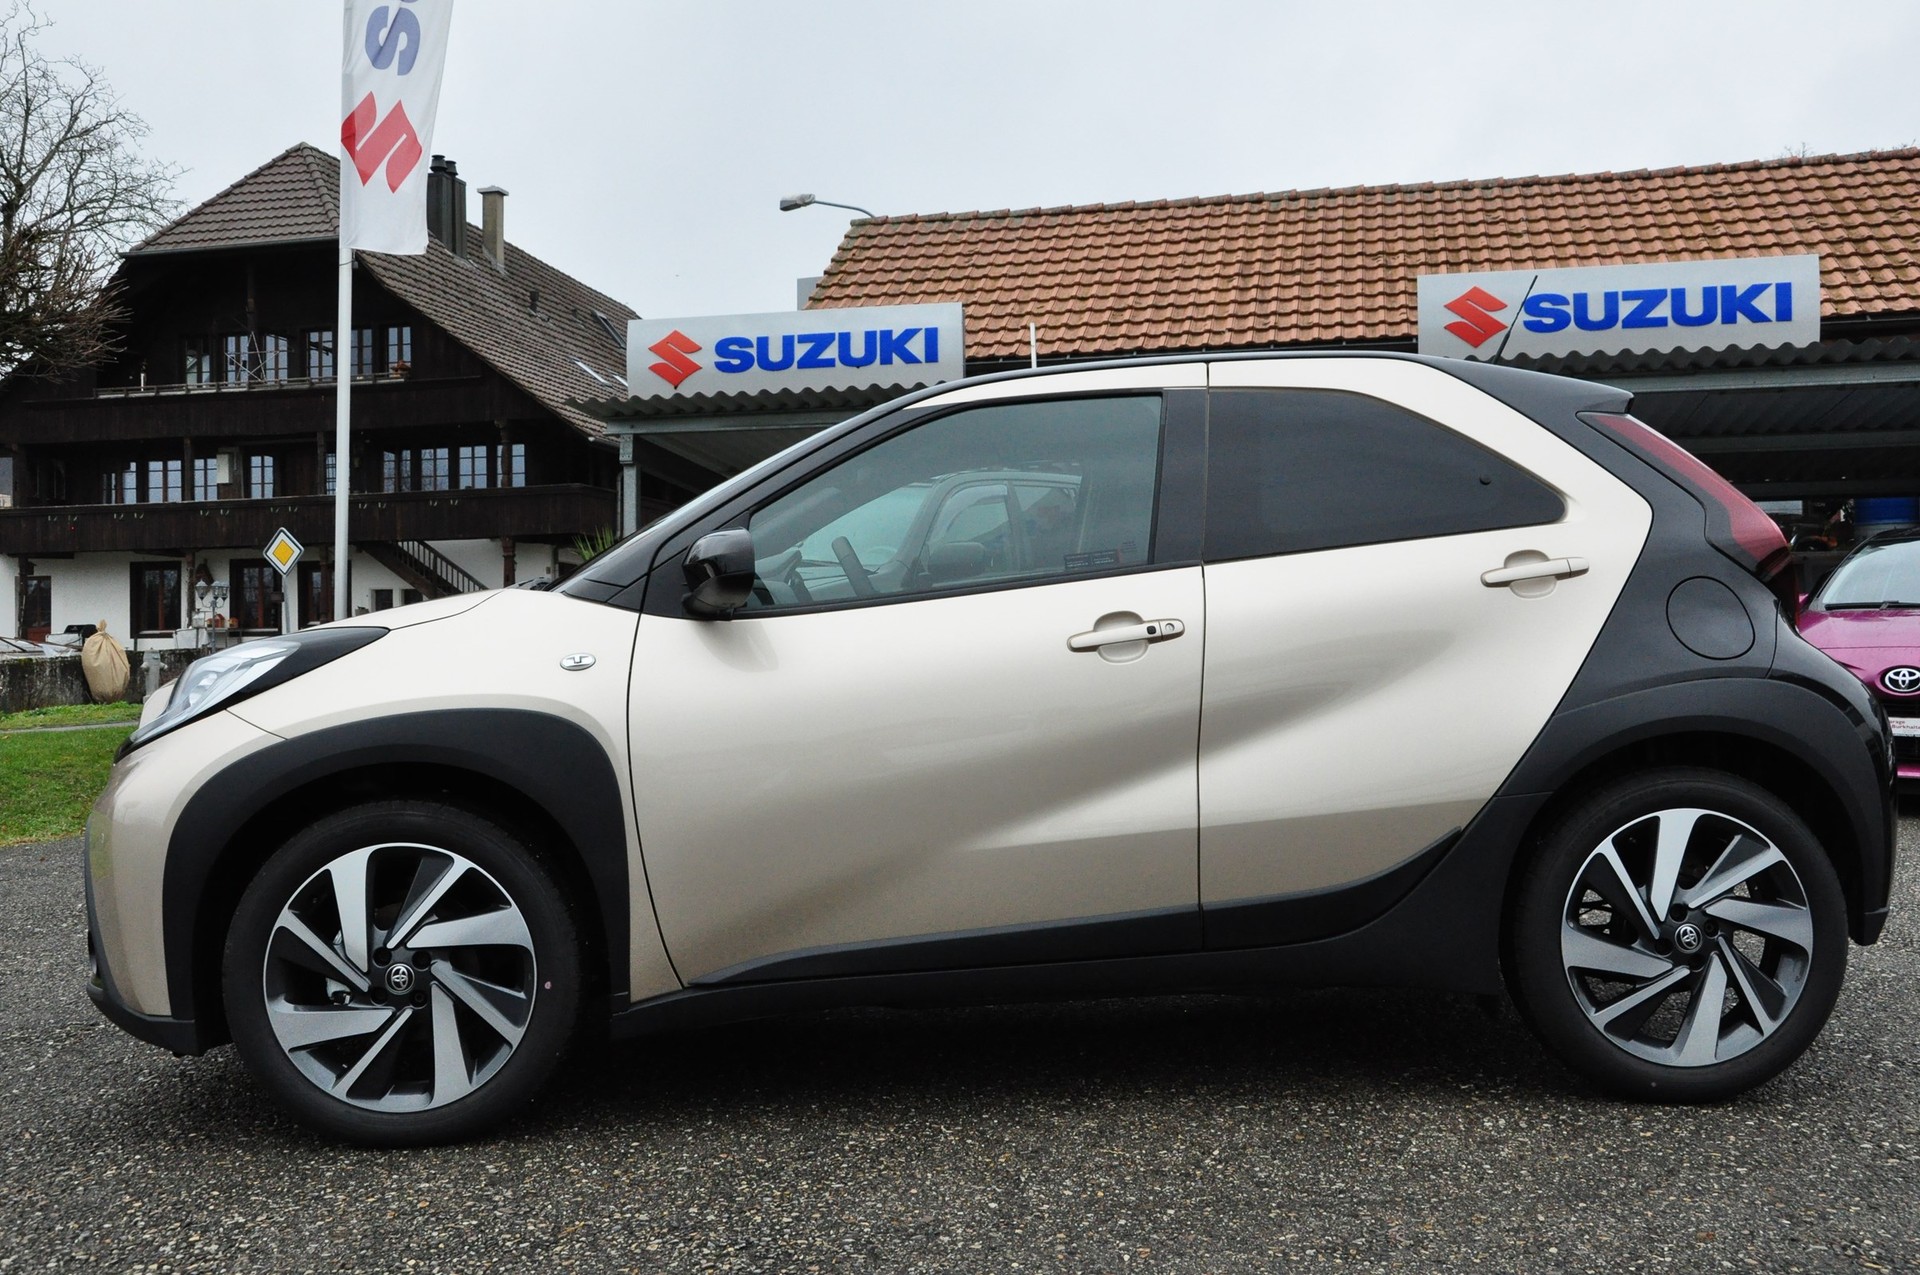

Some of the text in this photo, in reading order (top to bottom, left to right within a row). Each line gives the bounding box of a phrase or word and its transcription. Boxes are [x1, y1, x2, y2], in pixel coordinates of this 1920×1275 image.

[364, 0, 421, 76] S
[1523, 282, 1792, 333] SUZUKI
[714, 327, 939, 373] SUZUKI
